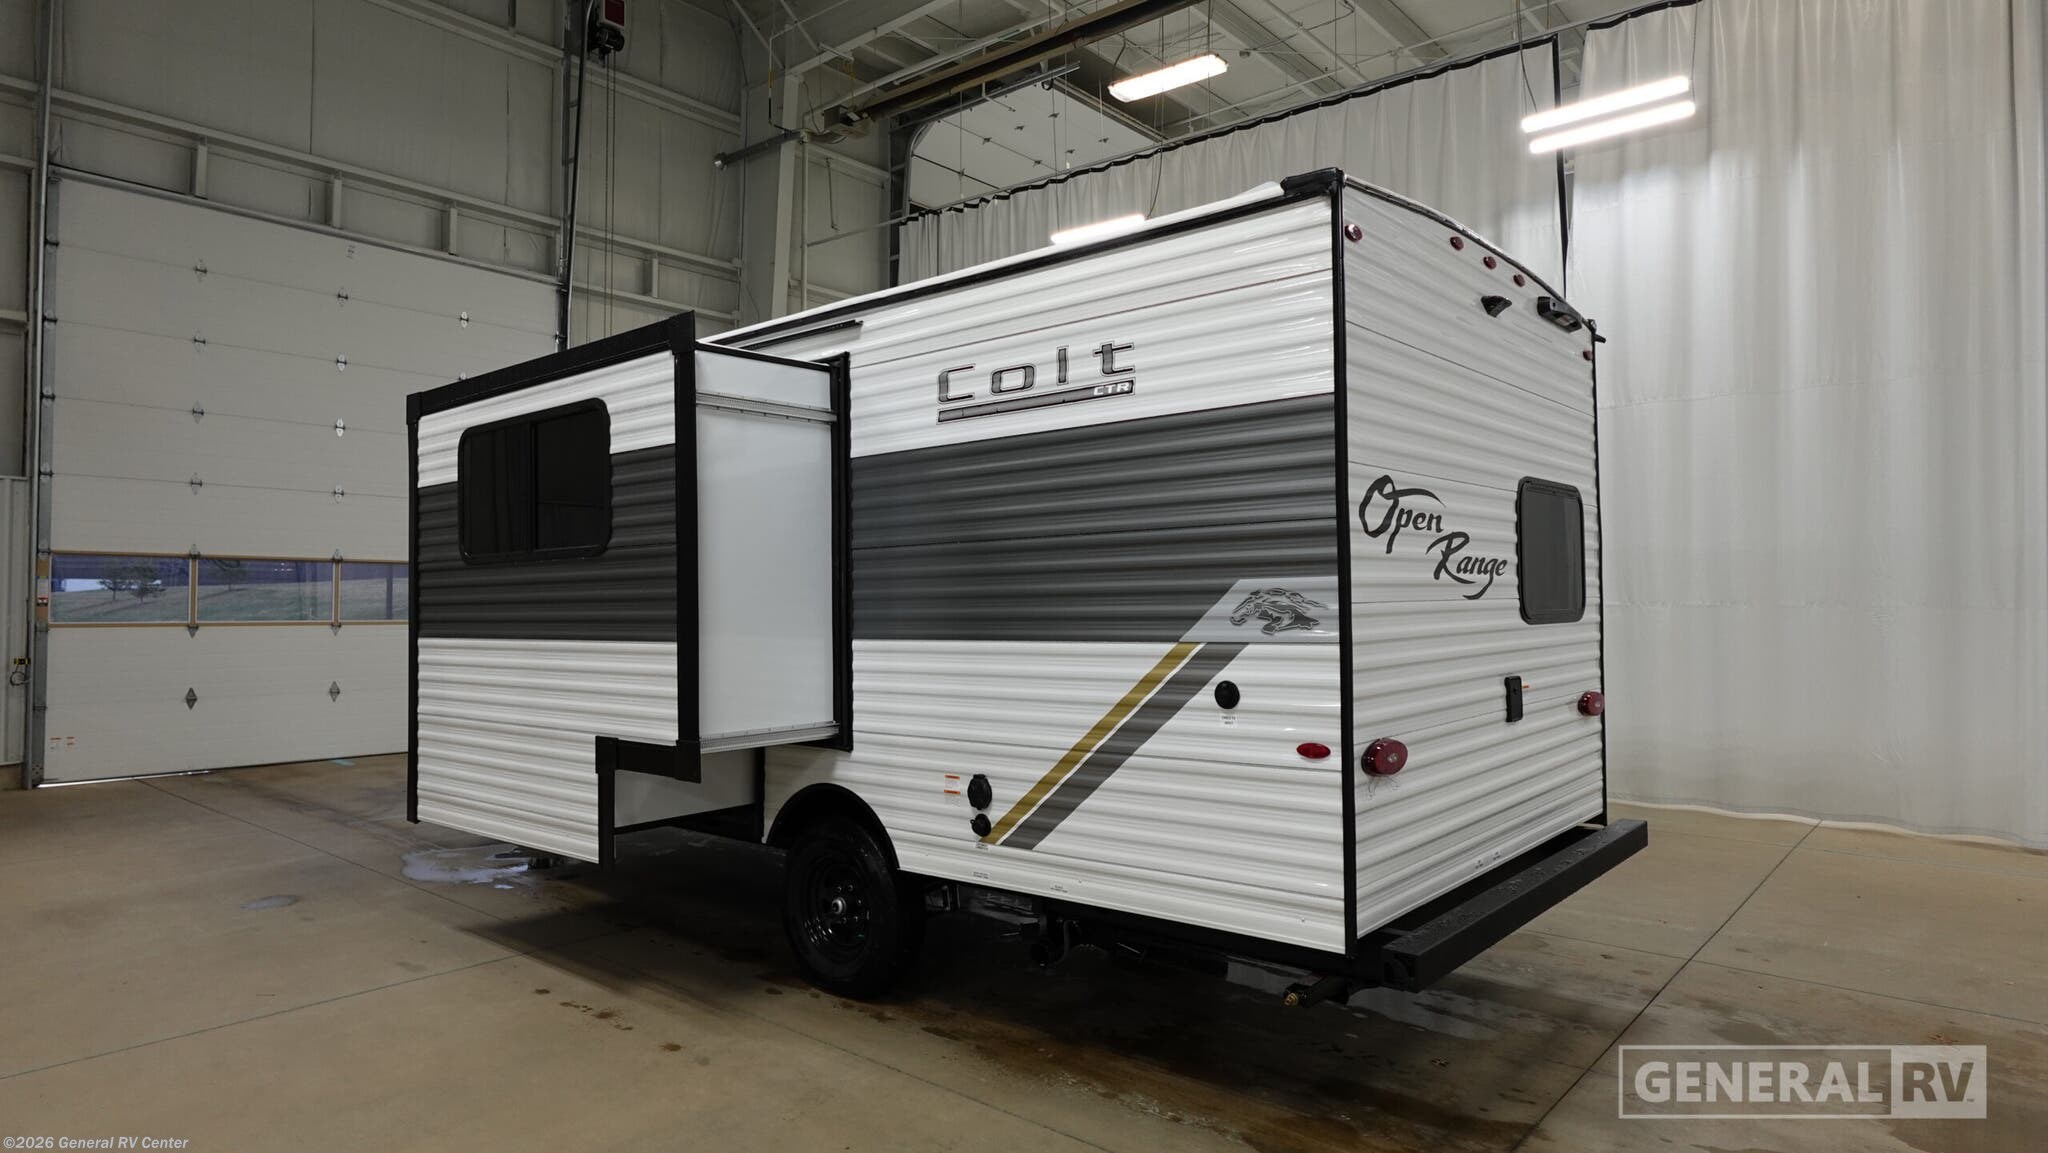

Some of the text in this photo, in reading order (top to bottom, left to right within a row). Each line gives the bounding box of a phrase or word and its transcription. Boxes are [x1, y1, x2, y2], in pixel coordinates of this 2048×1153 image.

[937, 341, 1135, 403] Colt
[1092, 382, 1130, 396] CTR
[1358, 474, 1446, 554] Open
[1425, 531, 1508, 600] Range
